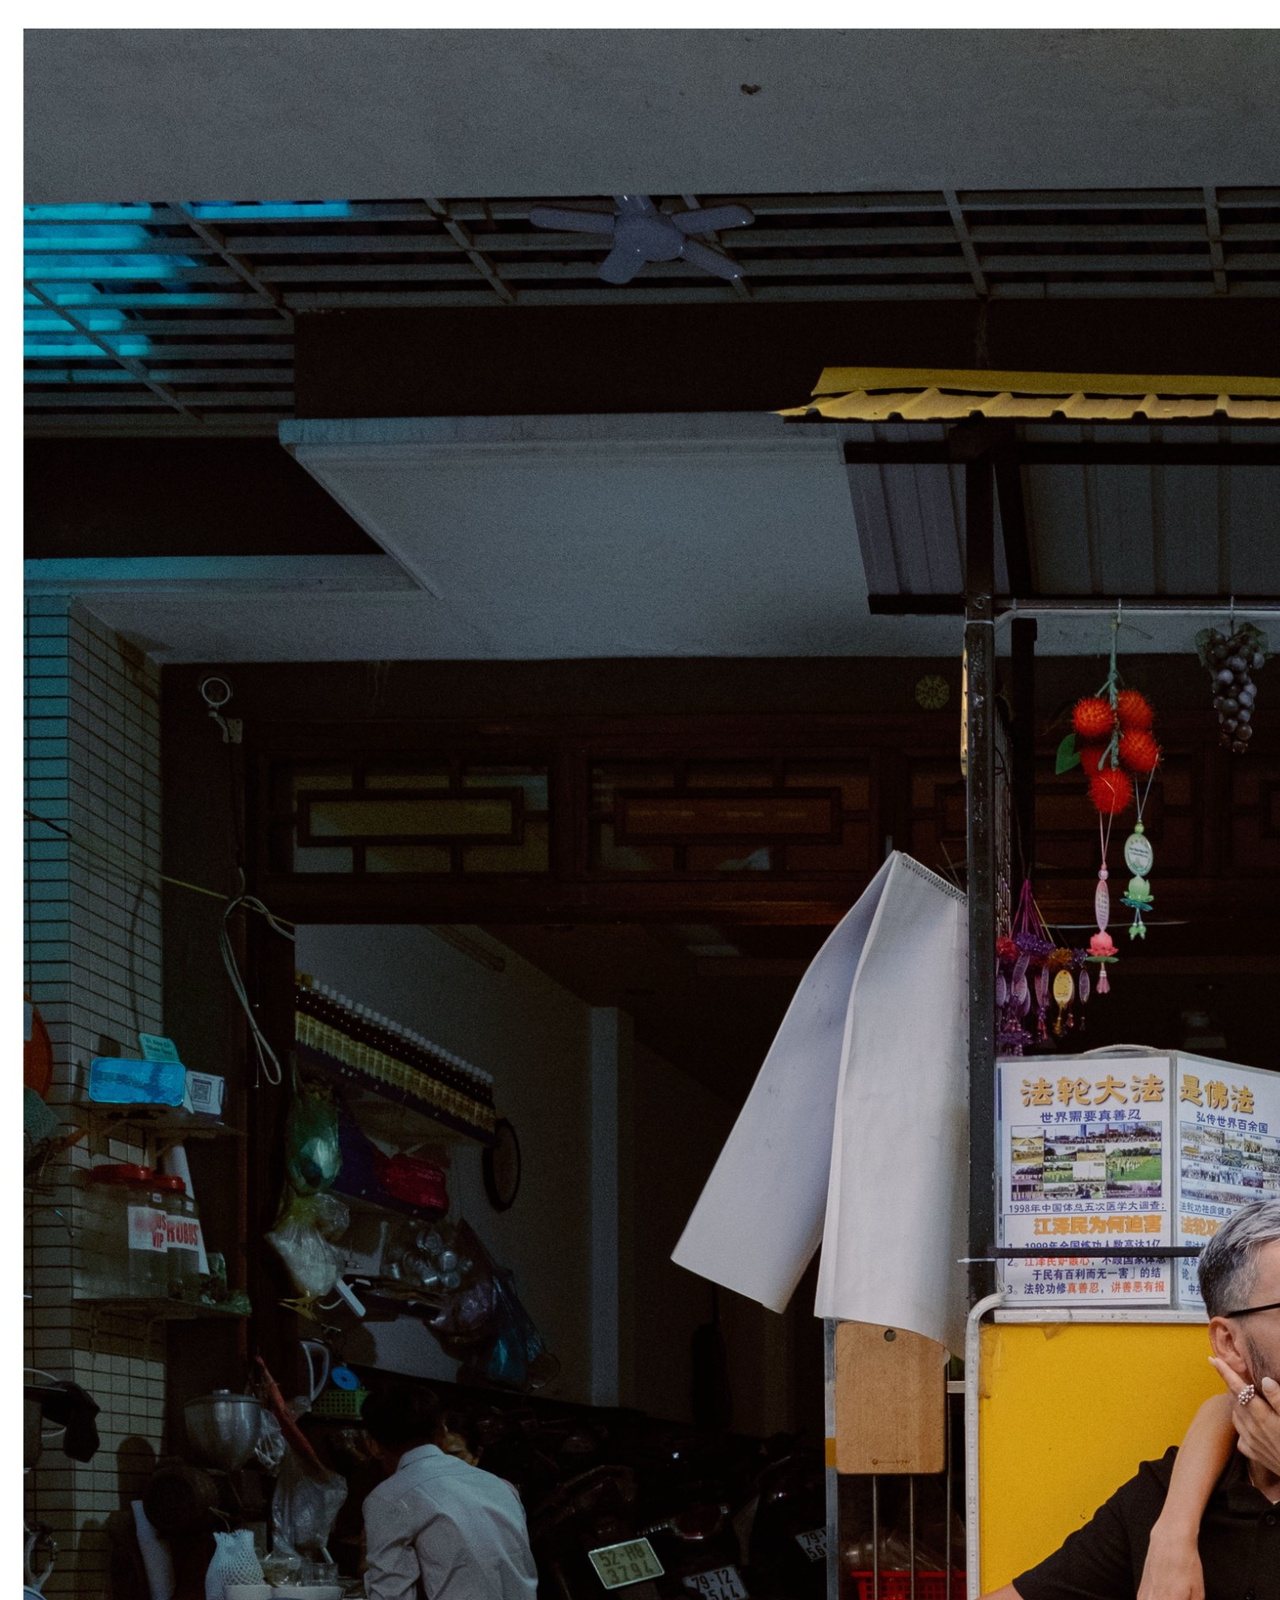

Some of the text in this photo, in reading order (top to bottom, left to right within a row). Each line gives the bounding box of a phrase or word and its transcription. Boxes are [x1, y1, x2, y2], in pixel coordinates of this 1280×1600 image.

[1020, 1073, 1254, 1114] 法轮大法 是佛法
[1040, 1109, 1141, 1123] 世界需要真善忍
[1196, 1111, 1269, 1134] 弘传世界百余国
[1034, 1215, 1162, 1236] 江泽民为何迫害
[801, 1529, 827, 1547] 79-
[691, 1569, 735, 1590] 79-T2
